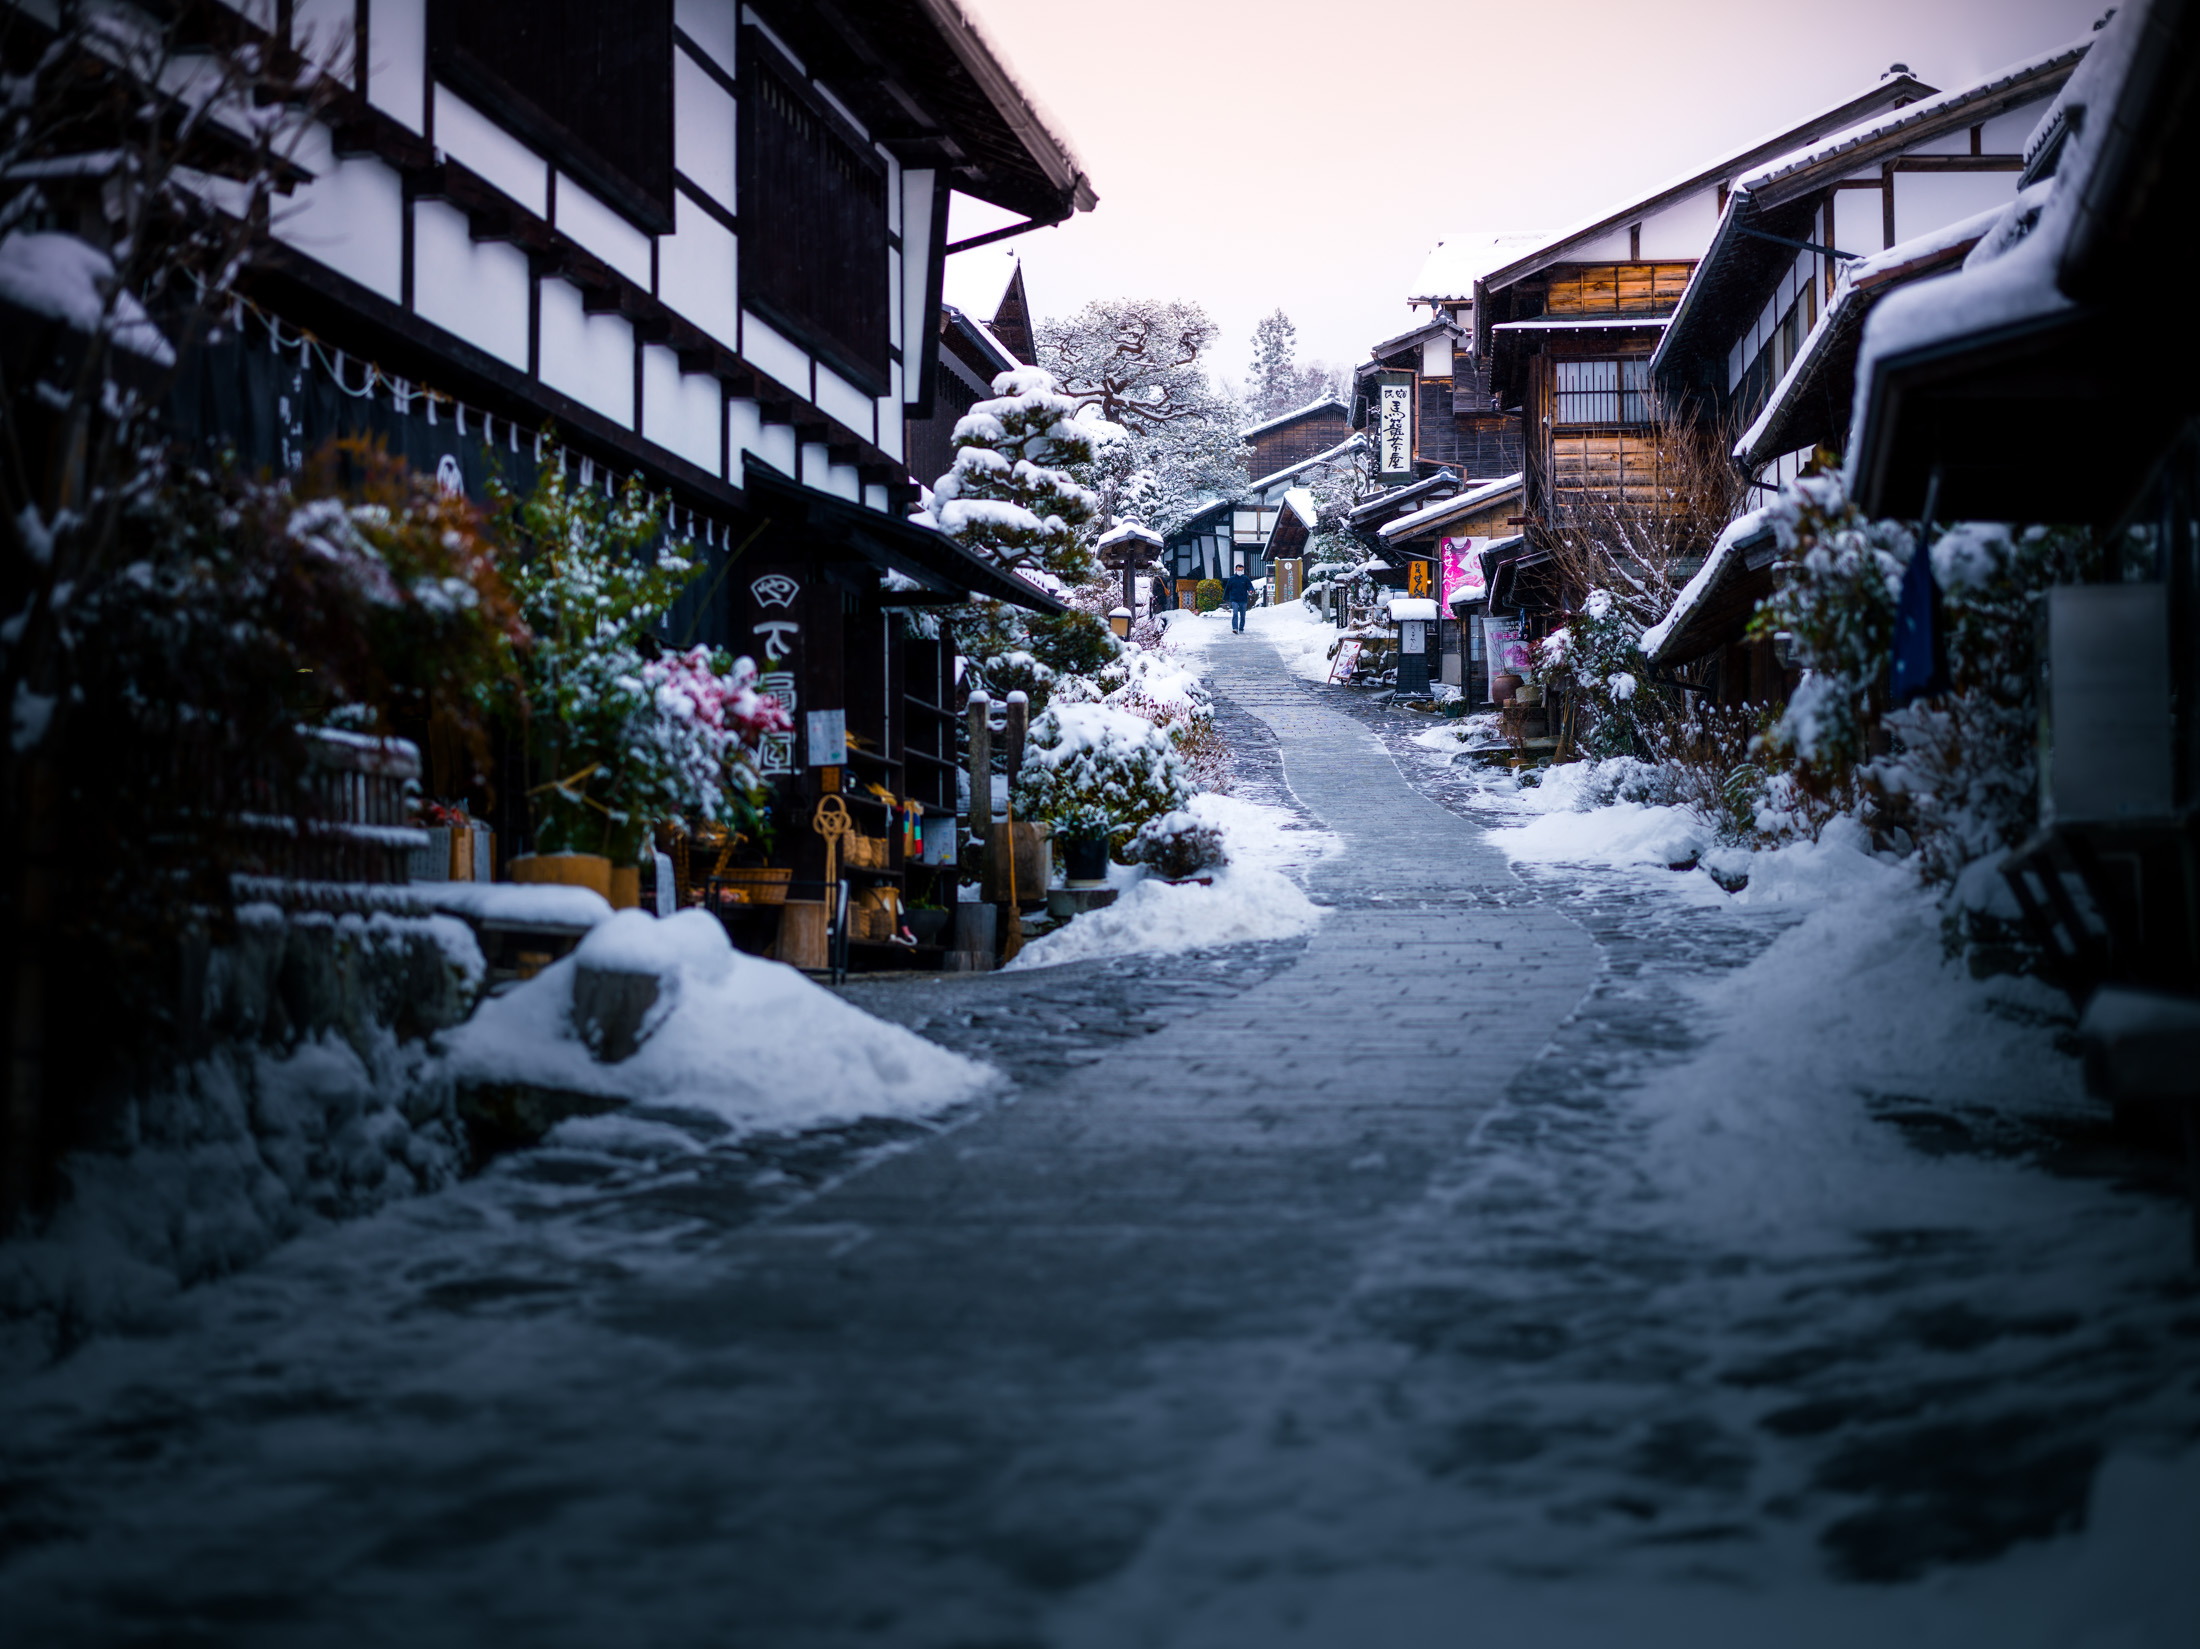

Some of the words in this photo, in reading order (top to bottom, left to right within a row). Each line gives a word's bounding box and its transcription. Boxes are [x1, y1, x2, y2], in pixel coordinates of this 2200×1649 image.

[1384, 389, 1408, 399] 民宿
[1383, 401, 1406, 469] 馬籠茶屋
